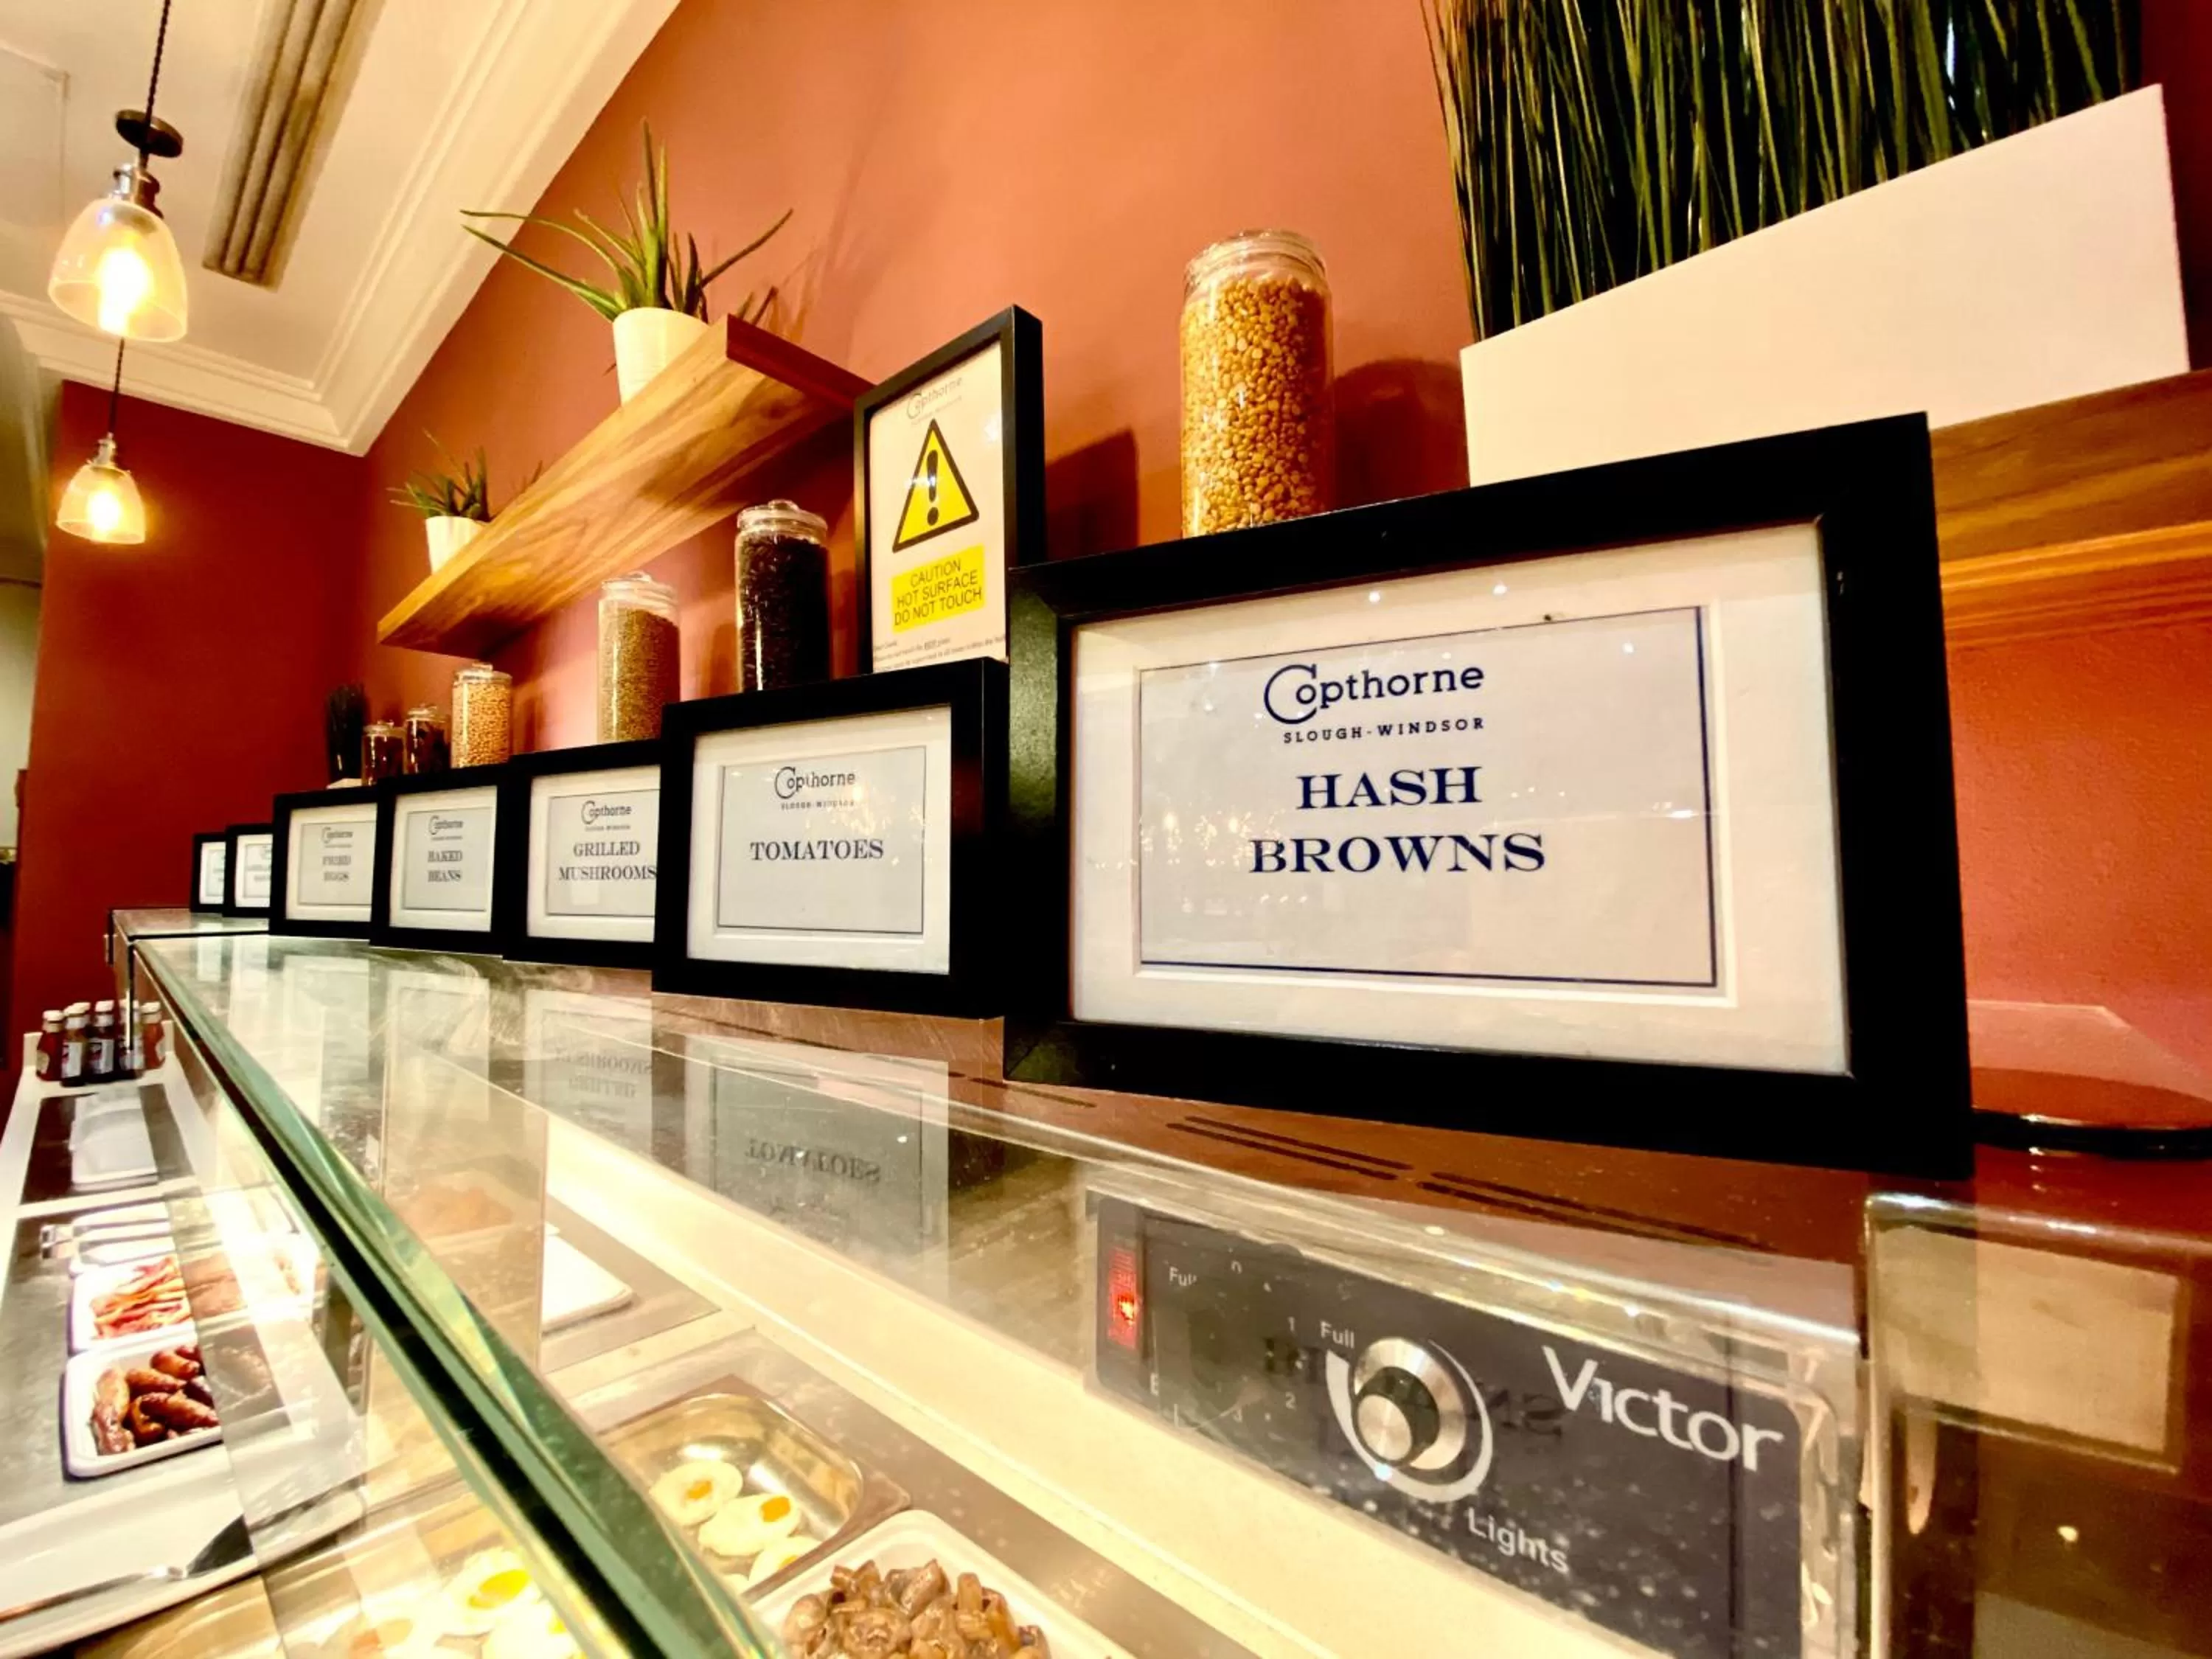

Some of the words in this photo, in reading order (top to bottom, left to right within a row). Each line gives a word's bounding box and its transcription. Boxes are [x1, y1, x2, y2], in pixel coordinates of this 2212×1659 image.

[897, 589, 919, 608] HOT
[922, 568, 978, 601] SURFACE
[910, 557, 961, 588] CAUTION
[894, 609, 911, 626] DO
[913, 600, 936, 619] NOT
[939, 586, 982, 611] TOUCH
[1263, 664, 1485, 724] Copthorne
[775, 766, 856, 799] Copthorne
[1296, 766, 1483, 810] HASH
[428, 849, 463, 863] BAKED
[573, 841, 641, 857] GRILLED
[750, 838, 884, 860] TOMATOES
[1249, 833, 1545, 873] BROWNS
[428, 869, 462, 883] BEANS
[558, 865, 658, 880] MUSHROOMS
[1168, 1265, 1198, 1287] Ful
[1320, 1321, 1355, 1349] Full
[1542, 1345, 1785, 1472] Victor
[1465, 1506, 1571, 1575] Lights
